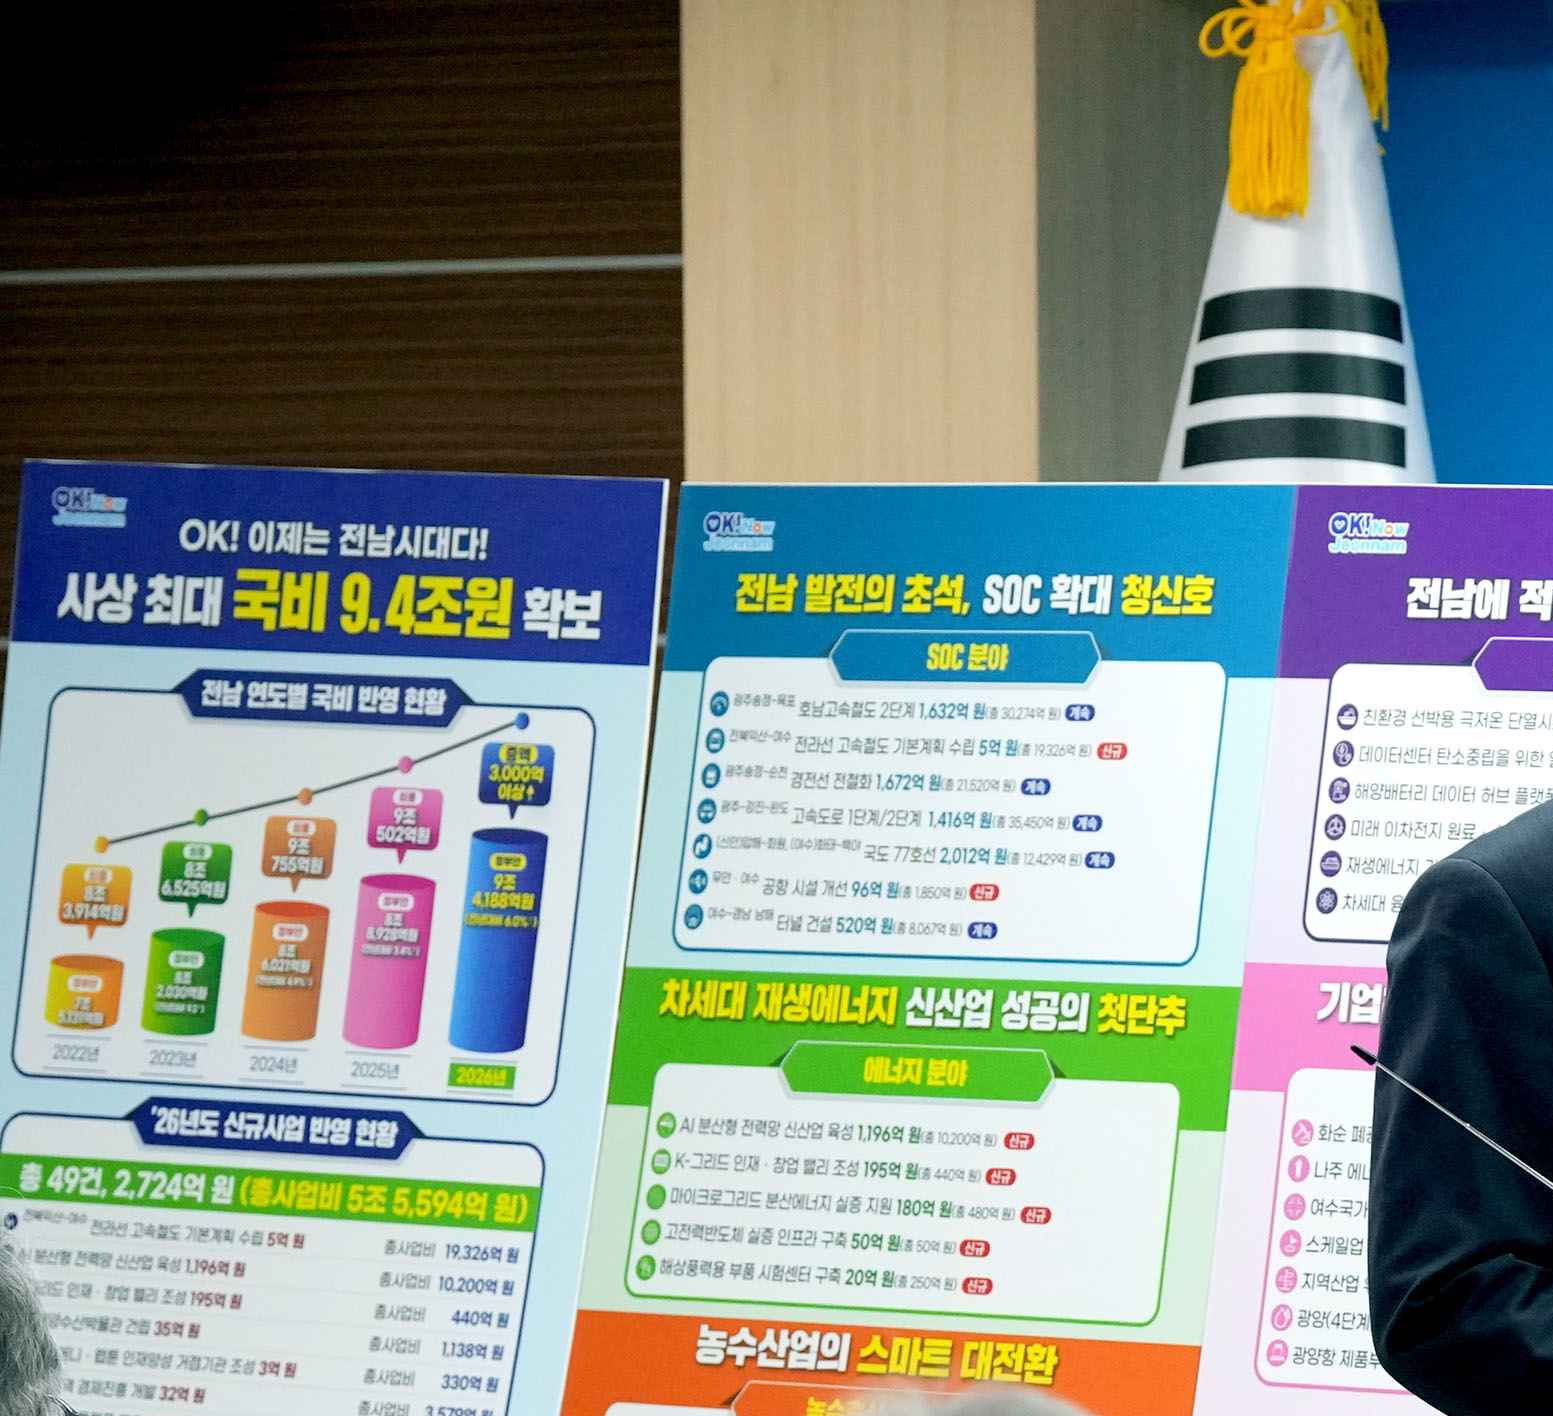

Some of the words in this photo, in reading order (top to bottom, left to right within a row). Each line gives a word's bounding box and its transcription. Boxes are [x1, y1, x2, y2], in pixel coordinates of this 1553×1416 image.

[178, 518, 240, 552] OK!
[247, 520, 330, 555] 이제는
[338, 523, 488, 560] 전남시대다!
[57, 572, 138, 623] 사상
[143, 573, 223, 626] 최대
[232, 567, 329, 632] 국비
[339, 571, 514, 639] 9.4조원
[522, 586, 602, 640] 확보
[735, 573, 798, 614] 전남
[804, 573, 895, 614] 발전의
[901, 573, 970, 614] 초석,
[982, 574, 1042, 613] SOC
[1049, 573, 1112, 614] 확대
[1120, 573, 1214, 615] 청신호
[1406, 577, 1510, 619] 전남에
[926, 642, 964, 670] SOC
[967, 642, 1009, 670] 분야
[201, 679, 244, 707] 전남
[246, 680, 308, 710] 연도별
[311, 683, 354, 712] 국비
[357, 685, 400, 714] 반영
[403, 686, 447, 716] 현황
[1363, 708, 1406, 726] 친환경
[1411, 710, 1454, 728] 선박용
[1460, 710, 1502, 729] 극저온
[1358, 745, 1431, 764] 데이터센터
[1436, 747, 1509, 767] 탄소중립을
[1514, 749, 1544, 767] 위한
[1351, 819, 1379, 836] 미래
[1384, 820, 1441, 838] 이차전지
[1447, 822, 1476, 840] 원료
[659, 978, 749, 1022] 차세대
[753, 982, 899, 1027] 재생에너지
[905, 986, 995, 1030] 신산업
[1001, 989, 1091, 1034] 성공의
[1097, 992, 1187, 1038] 첫단추
[863, 1056, 923, 1084] 에너지
[926, 1058, 968, 1086] 분야
[1318, 1124, 1347, 1143] 화순
[1314, 1161, 1342, 1180] 나주
[1305, 1236, 1363, 1256] 스케일업
[966, 1280, 989, 1293] 신규
[1301, 1273, 1359, 1293] 지역산업
[695, 1323, 851, 1373] 농수산업의
[857, 1335, 952, 1377] 스마트
[959, 1340, 1058, 1386] 대전환
[1292, 1345, 1336, 1367] 광양항
